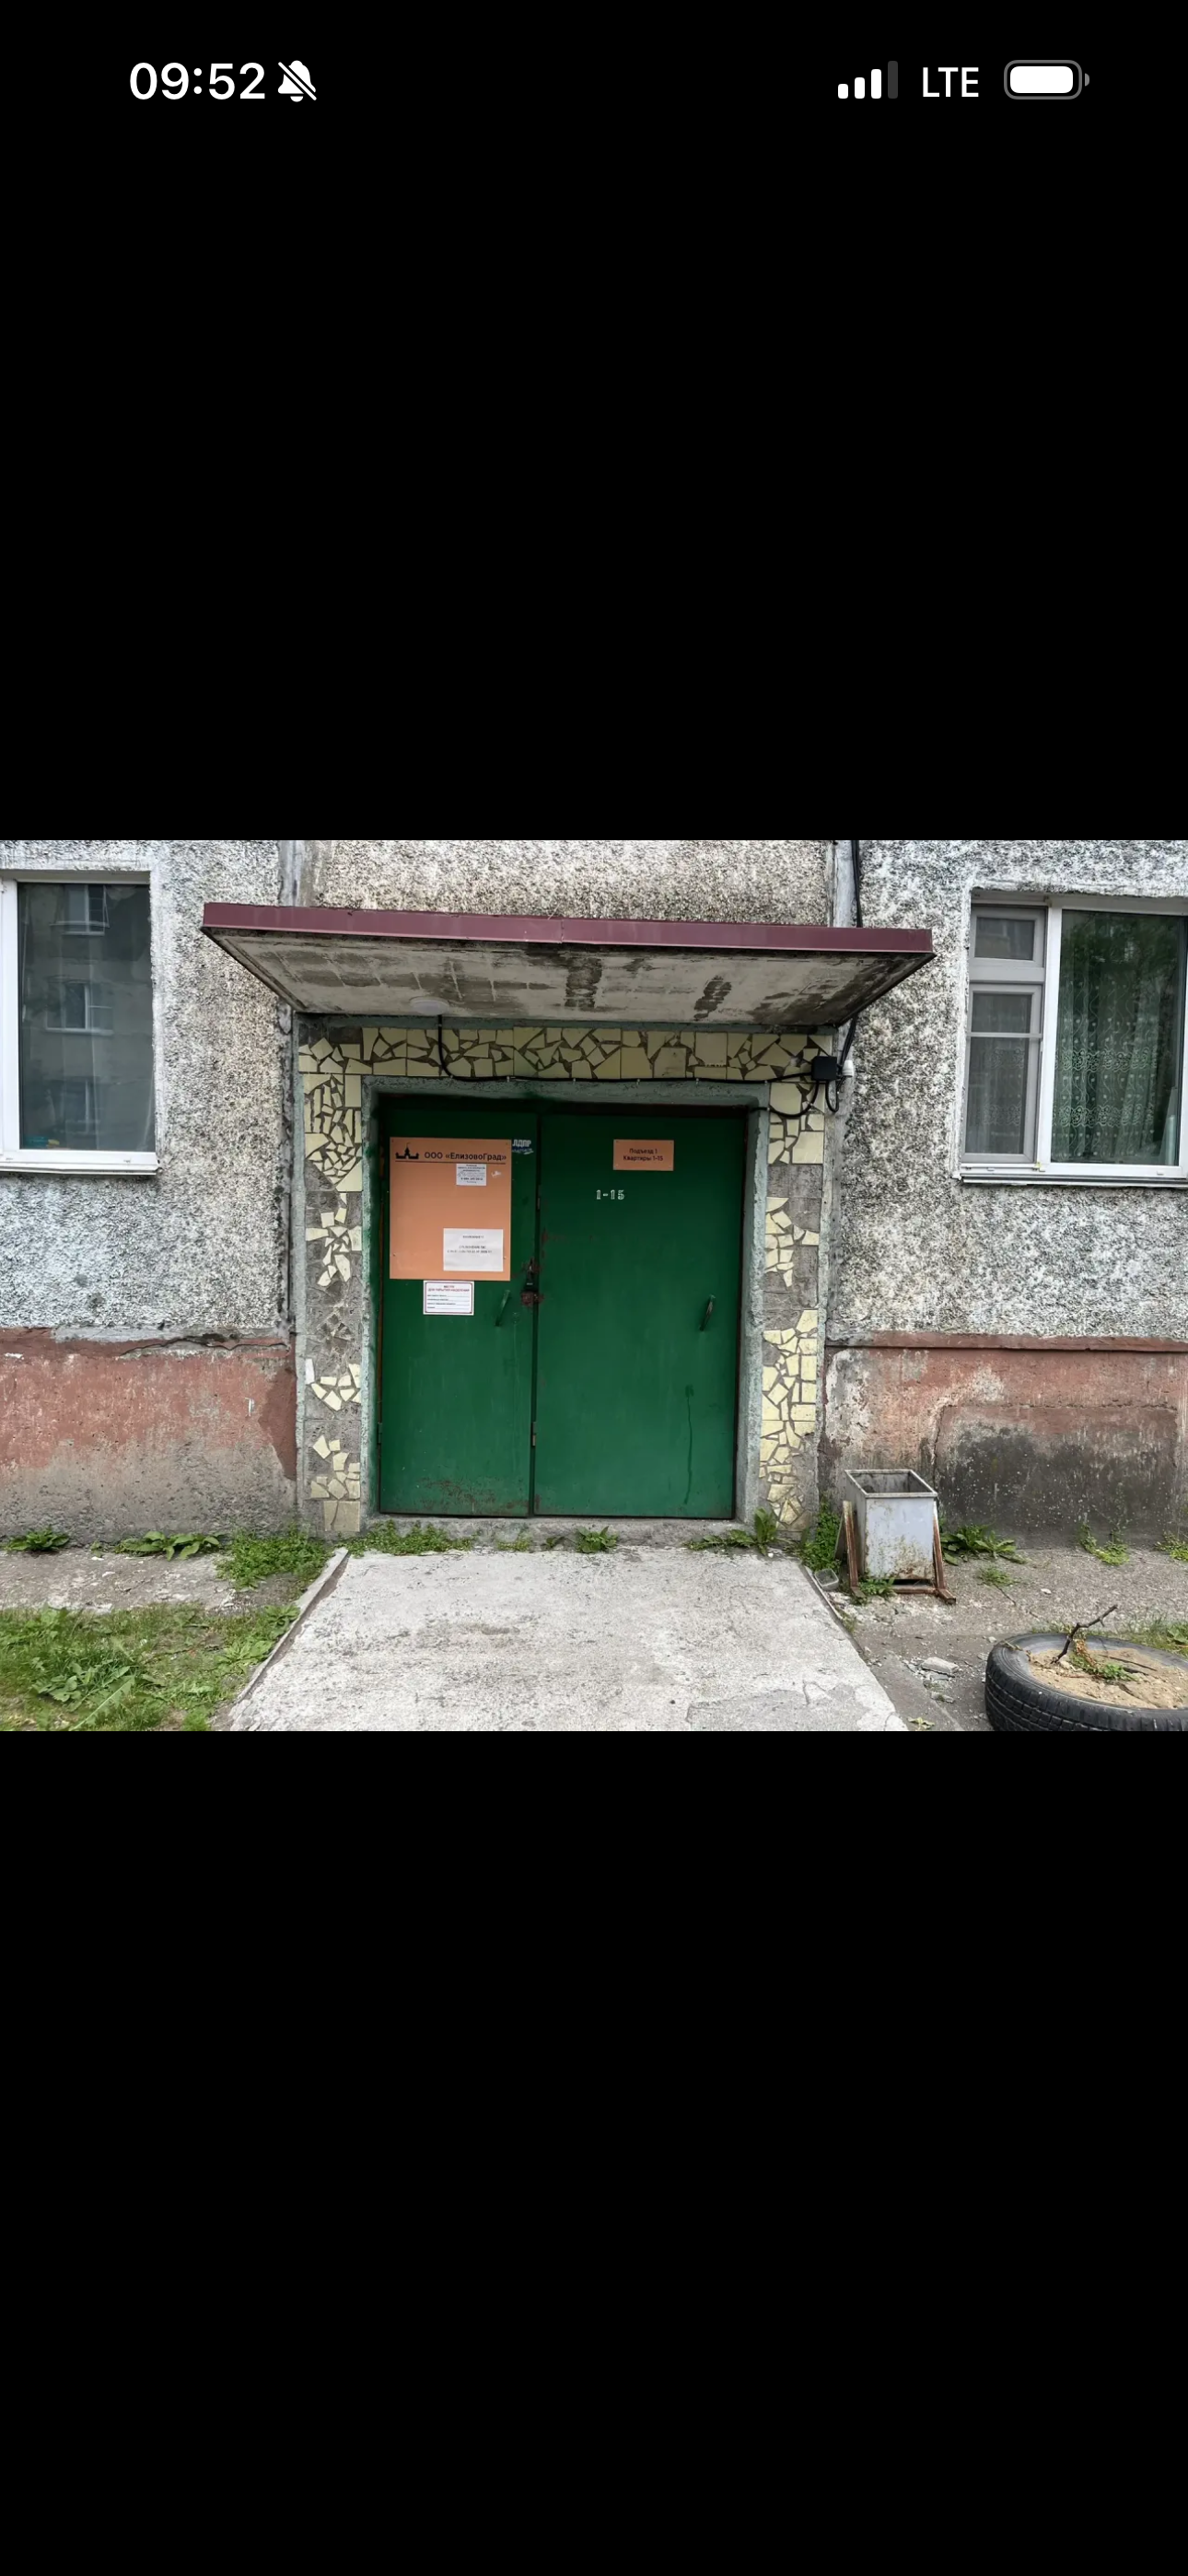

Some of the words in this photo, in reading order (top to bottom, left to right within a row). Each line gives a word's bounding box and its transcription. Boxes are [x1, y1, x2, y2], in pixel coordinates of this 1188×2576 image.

[512, 1139, 532, 1148] ЛДПР
[425, 1152, 443, 1160] ООО
[446, 1152, 507, 1162] «ЕлизовоГрад»
[596, 1189, 624, 1200] 1-15
